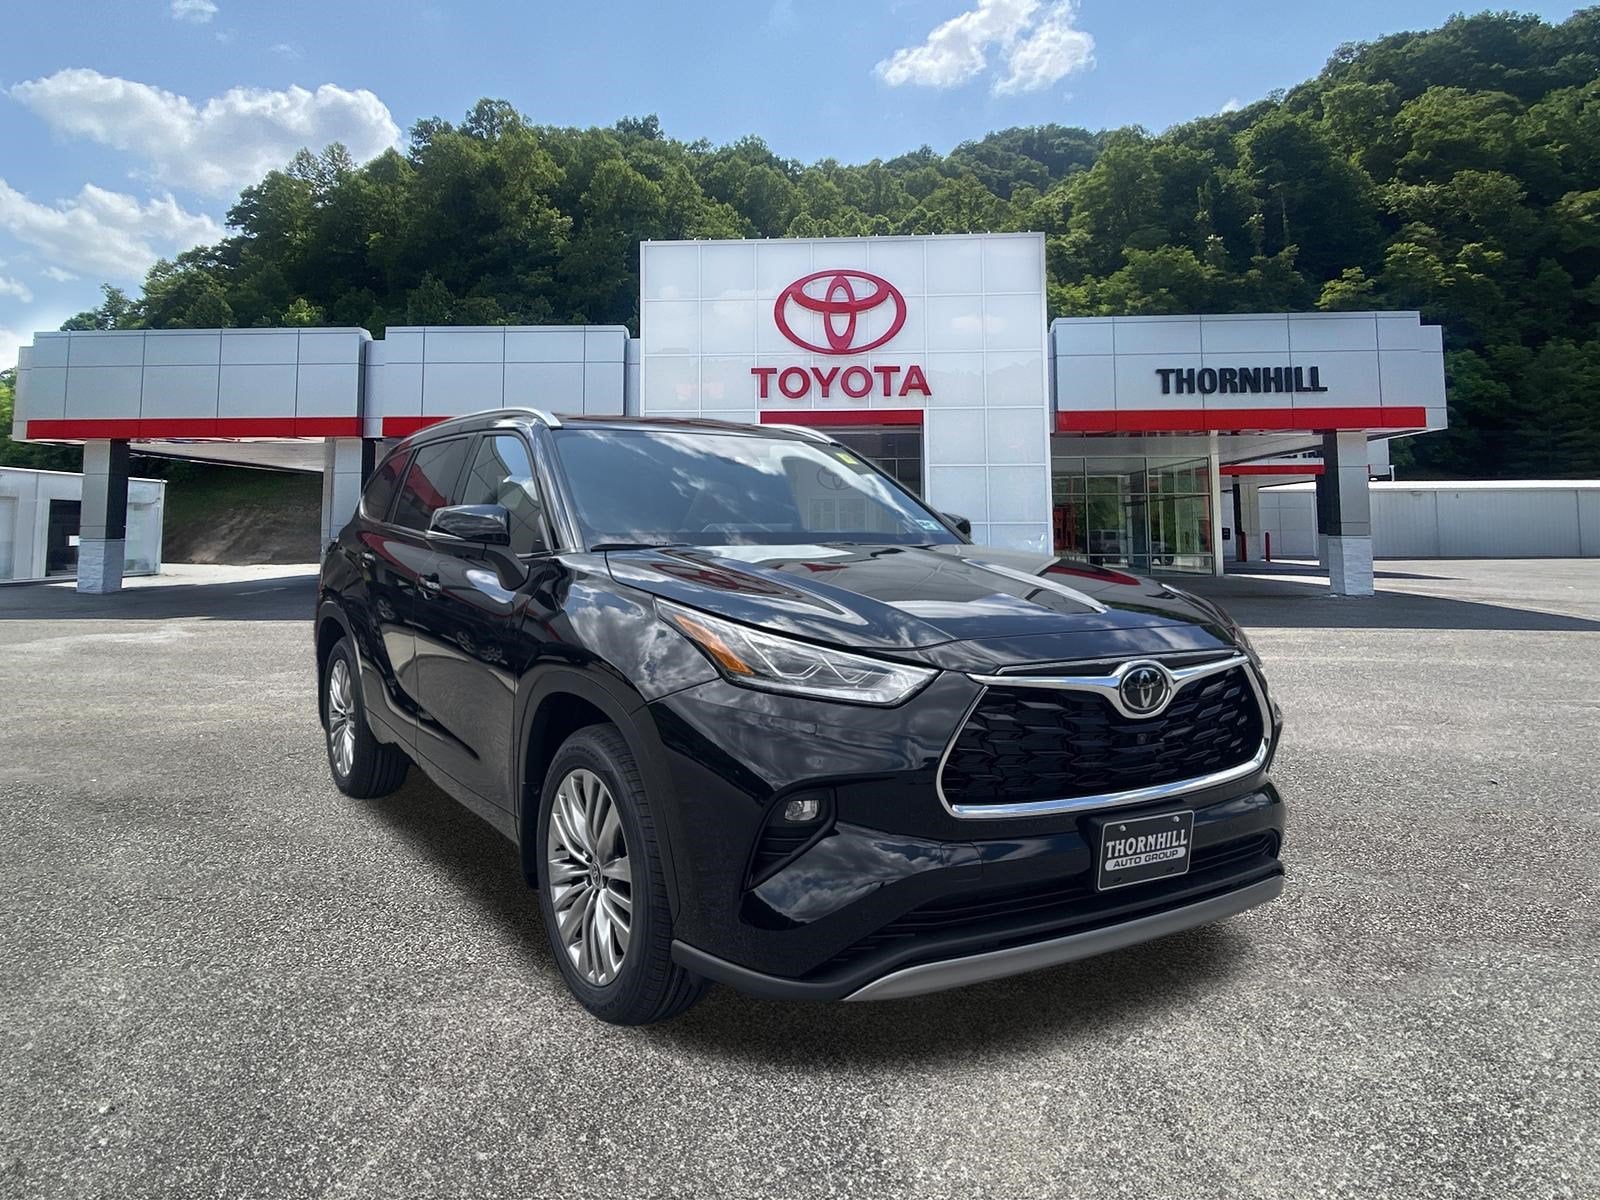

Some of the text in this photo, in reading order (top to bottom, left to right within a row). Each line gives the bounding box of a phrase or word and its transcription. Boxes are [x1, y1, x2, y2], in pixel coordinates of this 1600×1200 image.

[751, 365, 932, 399] TOYOTA
[1155, 366, 1328, 394] THORNHILL
[1106, 829, 1188, 858] THORNHILL
[1113, 849, 1179, 868] AUTO GROUP
